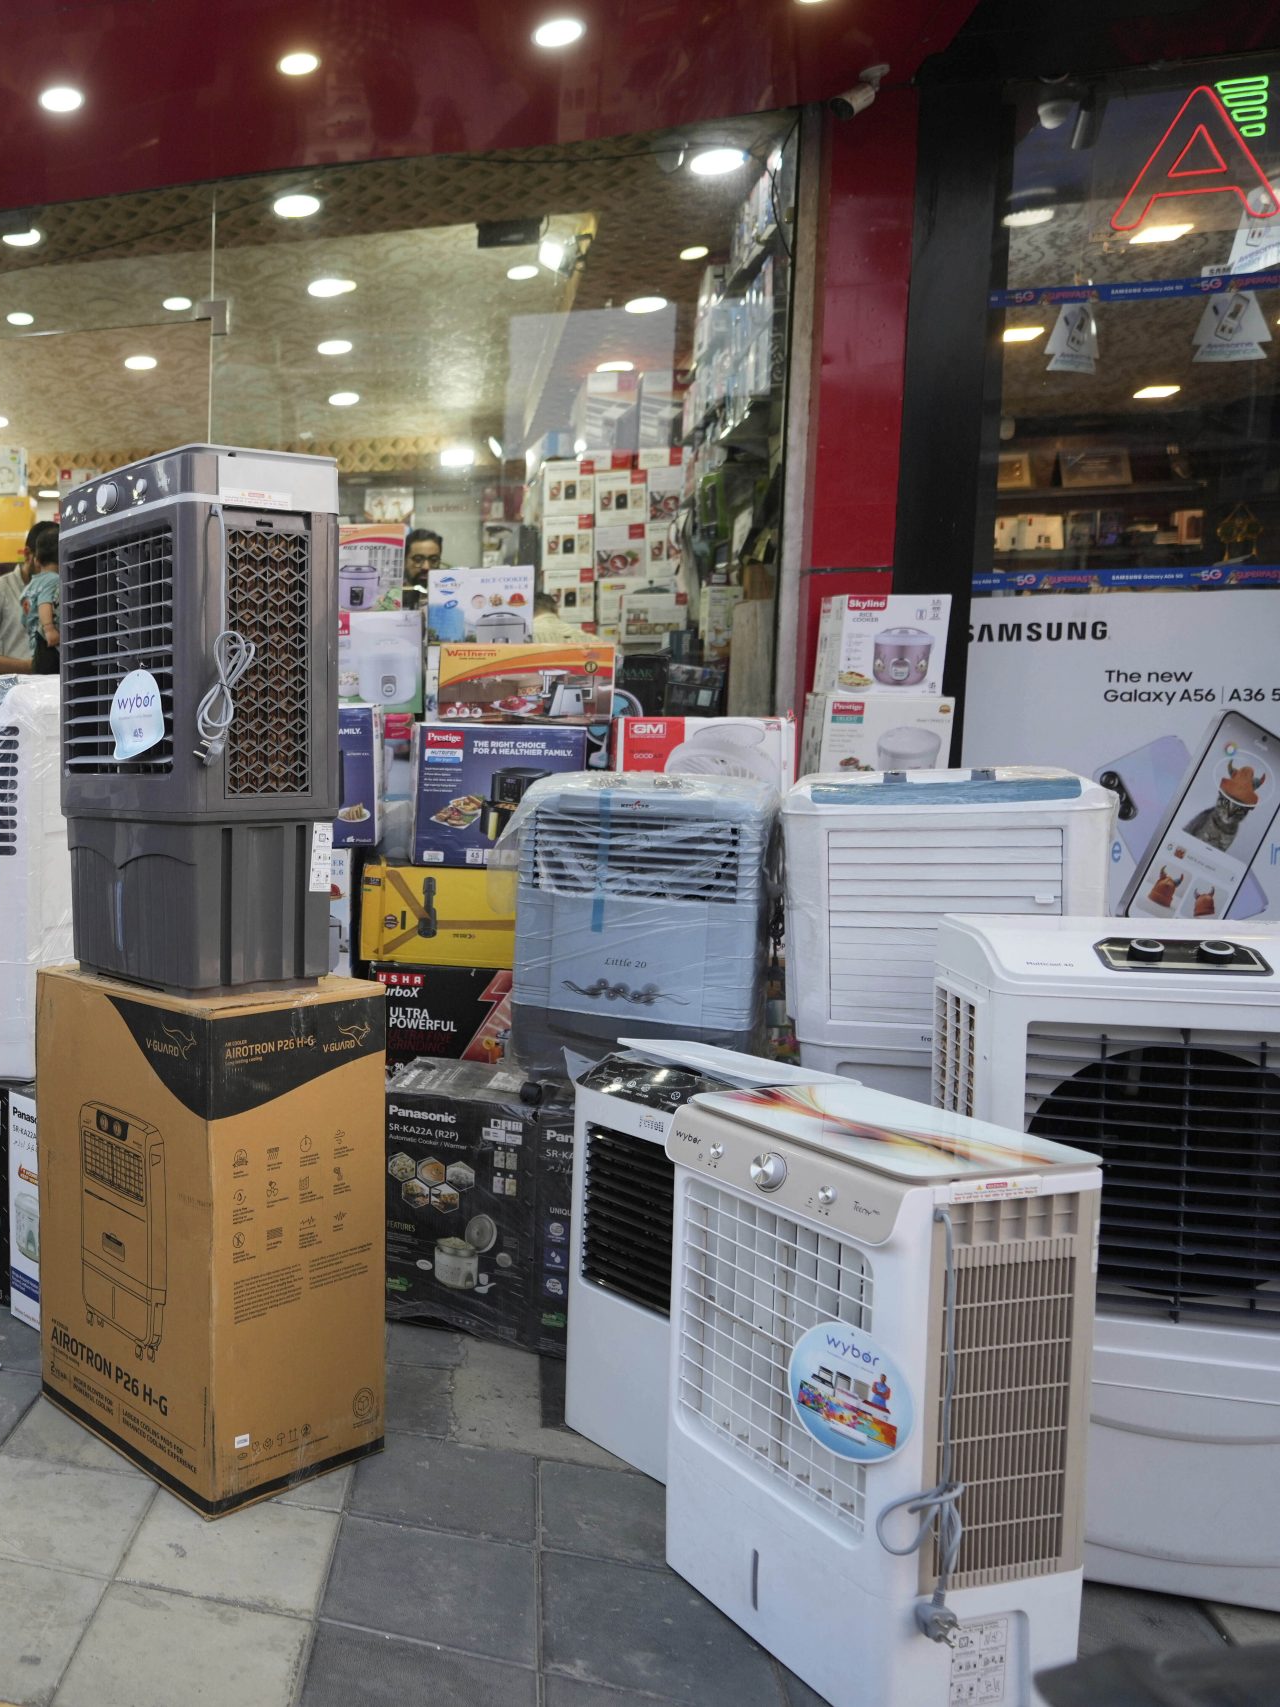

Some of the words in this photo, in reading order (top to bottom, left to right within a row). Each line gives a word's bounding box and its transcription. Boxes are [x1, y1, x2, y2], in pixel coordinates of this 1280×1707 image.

[1201, 278, 1221, 291] 5G
[1236, 272, 1280, 288] SUPERFAS
[1015, 290, 1034, 302] 5G
[1110, 287, 1141, 295] SAMSUNG
[1142, 286, 1163, 294] Galaxy
[1016, 574, 1036, 586] 5G
[1143, 573, 1163, 581] Galaxy
[1200, 569, 1222, 581] 5G
[1235, 570, 1280, 581] SUPERFAS
[848, 599, 887, 610] Skyline
[1105, 669, 1141, 683] The
[1147, 671, 1193, 683] new
[1103, 688, 1176, 706] Galaxy
[1179, 688, 1216, 702] A56
[1228, 688, 1265, 702] A36
[833, 702, 863, 712] Prestige
[631, 722, 665, 736] GM
[427, 732, 461, 744] Prestige
[474, 740, 489, 748] THE
[491, 740, 514, 749] RIGHT
[517, 741, 546, 749] CHOICE
[473, 747, 490, 755] FOR
[499, 748, 542, 756] HEALTHIER
[543, 749, 573, 757] FAMILY.
[604, 957, 632, 967] Little
[634, 960, 647, 969] 20
[378, 974, 422, 985] USHA
[384, 986, 419, 998] urboX
[389, 1006, 429, 1020] ULTRA
[389, 1018, 457, 1032] POWERFUL
[225, 1042, 275, 1059] AIROTRON
[277, 1039, 294, 1051] P26
[296, 1035, 314, 1048] H-G
[13, 1107, 36, 1124] Panas
[388, 1105, 457, 1124] Panasonic
[389, 1123, 433, 1137] SR-KA22A
[435, 1128, 459, 1141] (R2P)
[389, 1133, 417, 1144] Automatic
[418, 1137, 439, 1147] Cooker
[444, 1141, 467, 1150] Warmer
[549, 1206, 572, 1217] UNIQU
[51, 1326, 112, 1379] AIROTRON
[115, 1366, 139, 1397] P26
[143, 1383, 168, 1417] H-G
[95, 1398, 114, 1417] COOLING
[104, 1394, 113, 1407] FOR
[122, 1408, 140, 1426] LARGER
[140, 1419, 160, 1440] COOLING
[160, 1432, 173, 1448] PADS
[173, 1442, 184, 1456] FOR
[122, 1417, 147, 1440] ENHANCED
[146, 1431, 167, 1454] COOLING
[167, 1445, 197, 1475] EXPERIENCE
